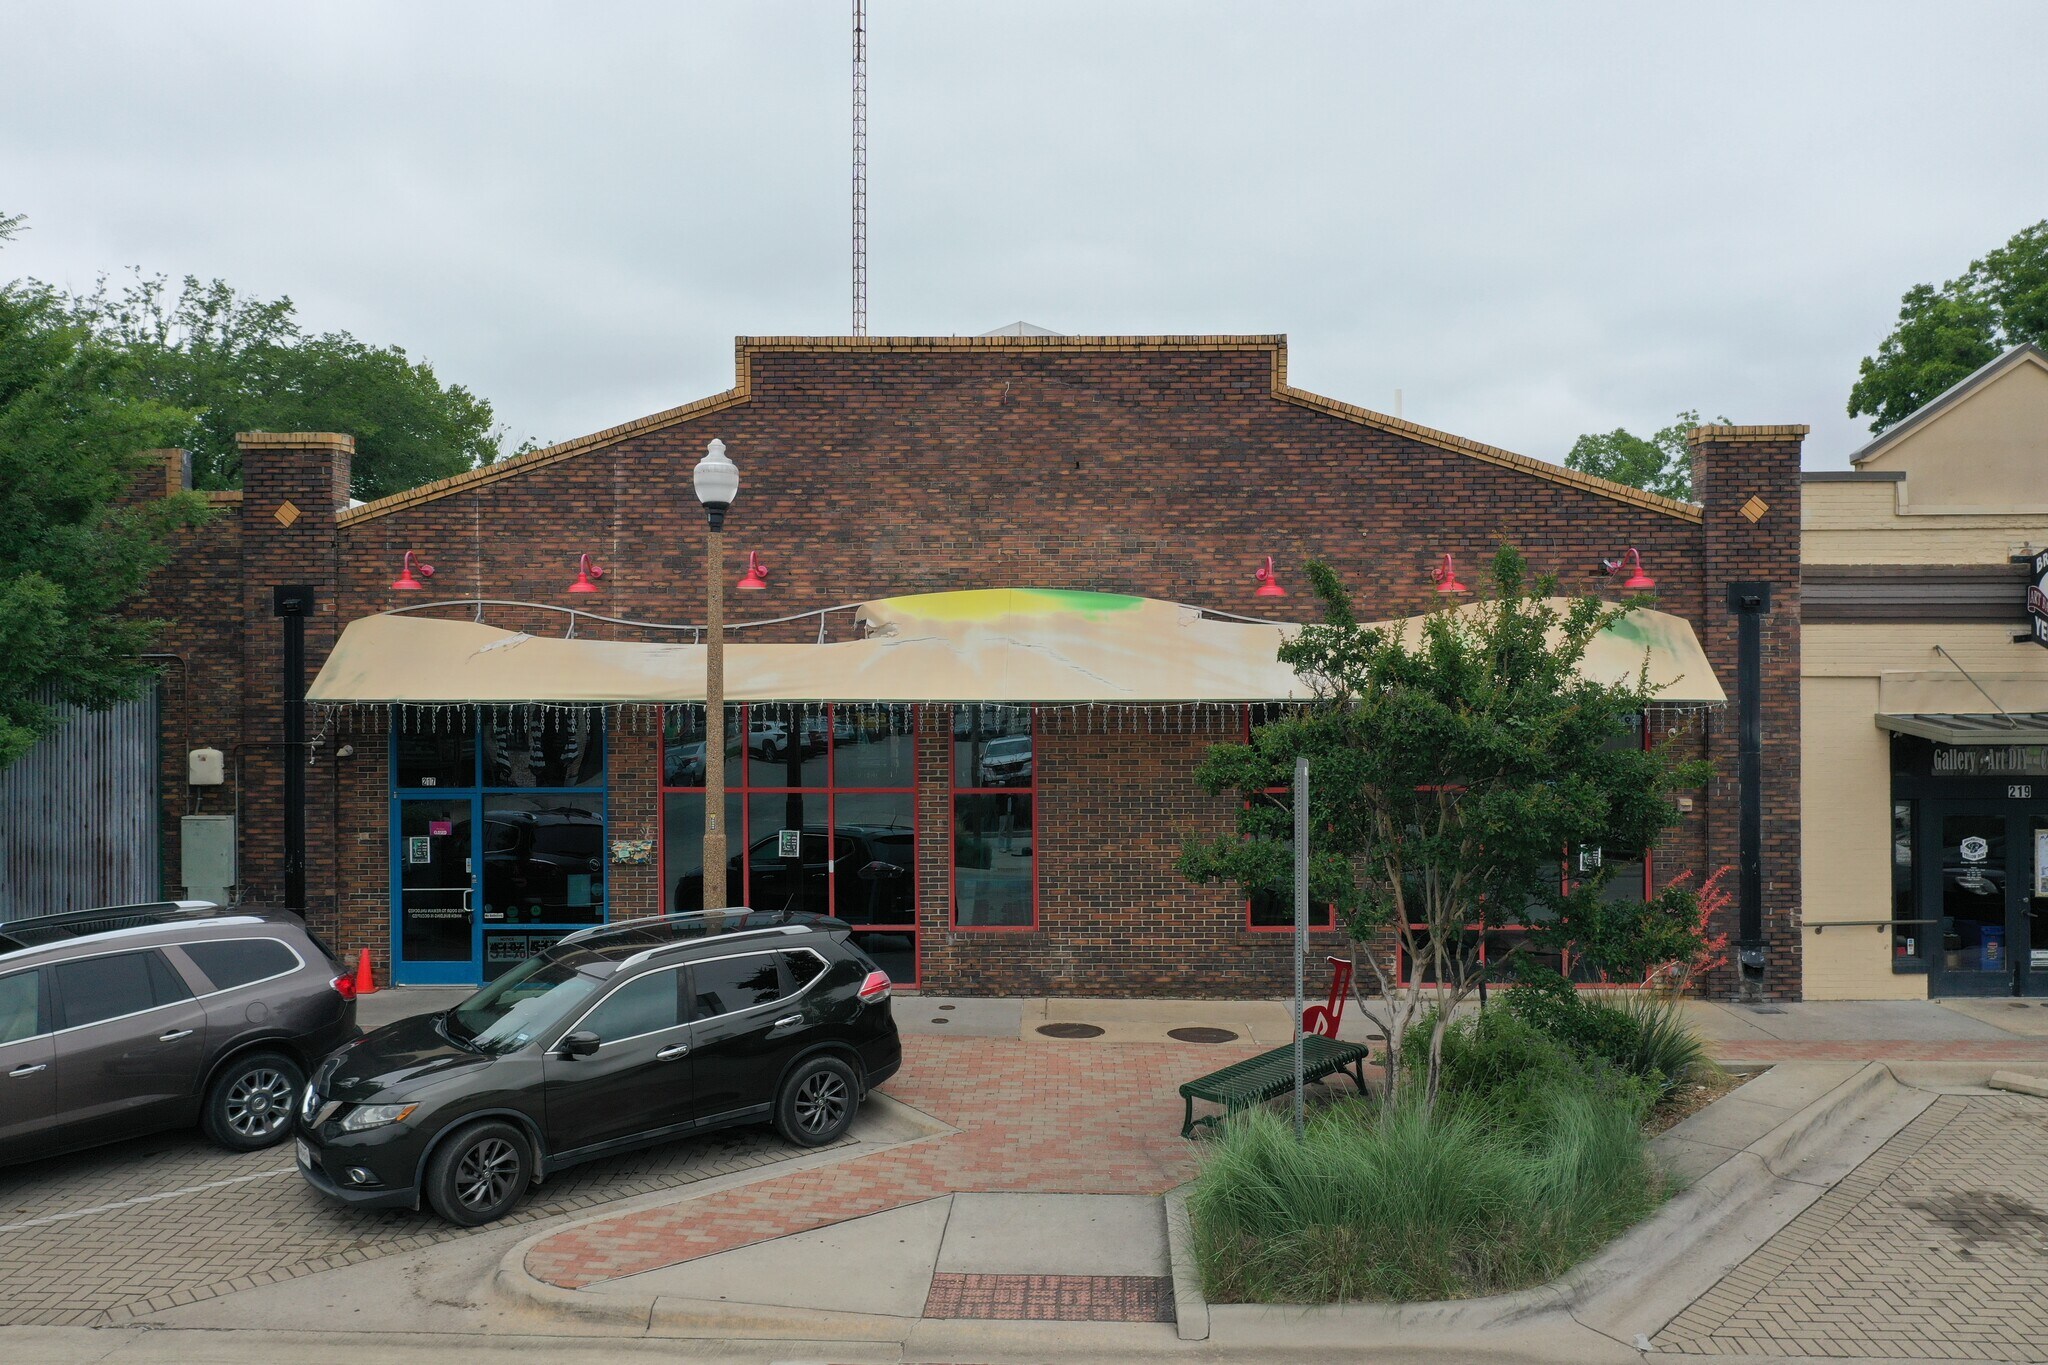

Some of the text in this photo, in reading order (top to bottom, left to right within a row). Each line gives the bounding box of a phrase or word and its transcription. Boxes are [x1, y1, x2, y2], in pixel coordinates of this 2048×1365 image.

[1933, 748, 1976, 773] Gallery
[1986, 748, 2006, 770] Art
[2008, 748, 2028, 770] DIY
[422, 777, 436, 786] 217
[2008, 786, 2031, 798] 219
